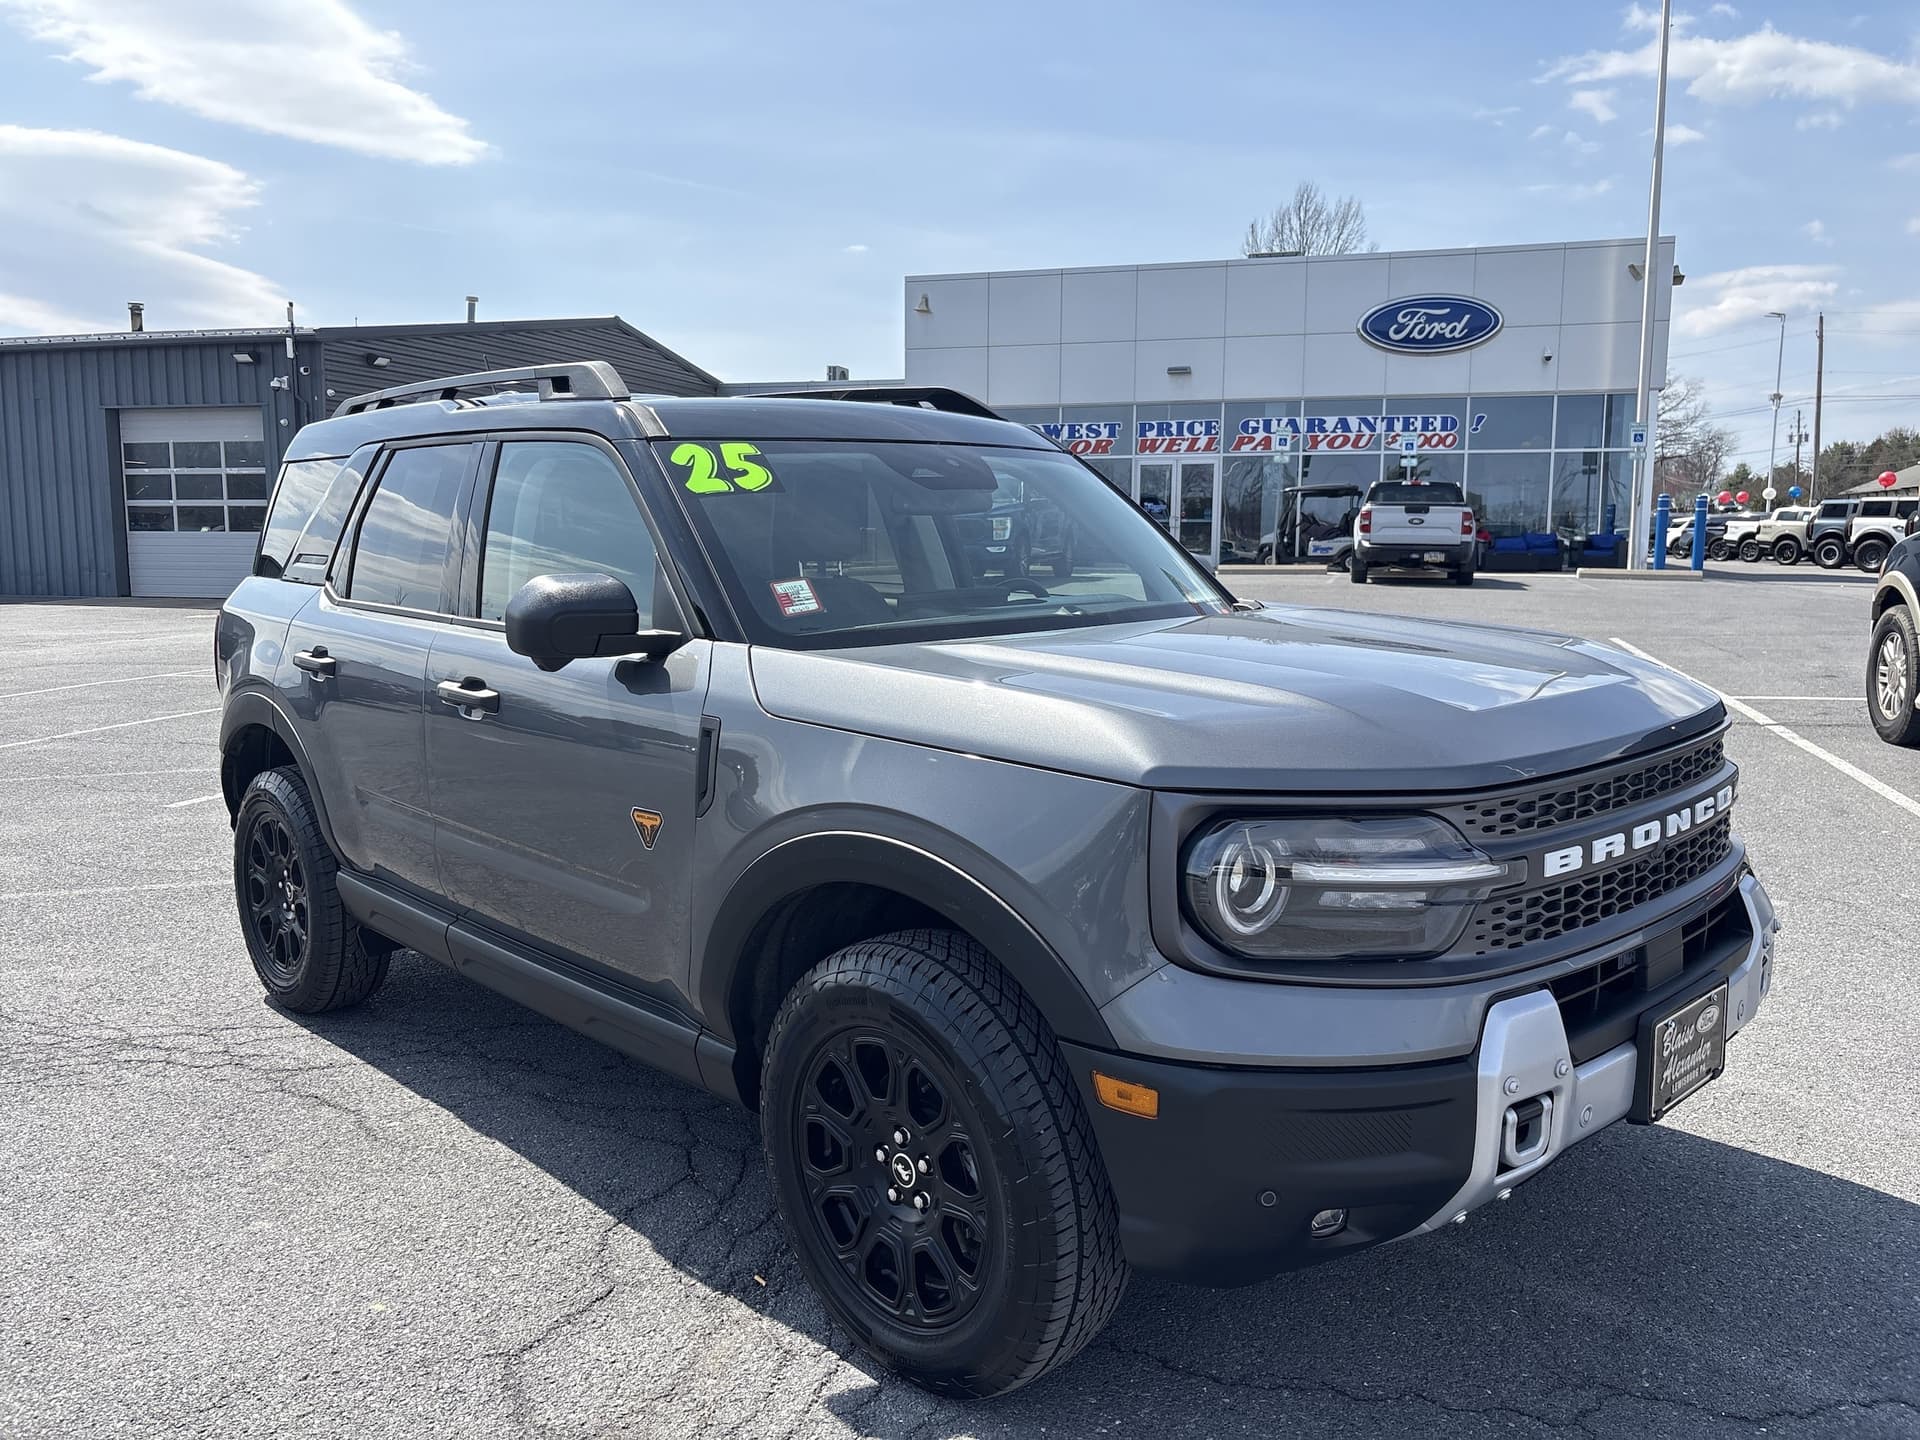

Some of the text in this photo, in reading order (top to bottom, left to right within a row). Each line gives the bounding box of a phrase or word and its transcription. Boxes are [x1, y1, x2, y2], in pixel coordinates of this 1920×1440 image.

[1388, 308, 1471, 340] Ford
[1031, 423, 1122, 440] WEST
[1138, 420, 1219, 438] PRICE
[1240, 415, 1459, 435] GUARANTEED
[1070, 439, 1114, 454] OR
[1138, 436, 1218, 453] WE'LL
[1230, 435, 1299, 451] PA
[1306, 434, 1376, 450] YOU
[670, 442, 773, 494] 25
[1543, 785, 1733, 878] BRONCO
